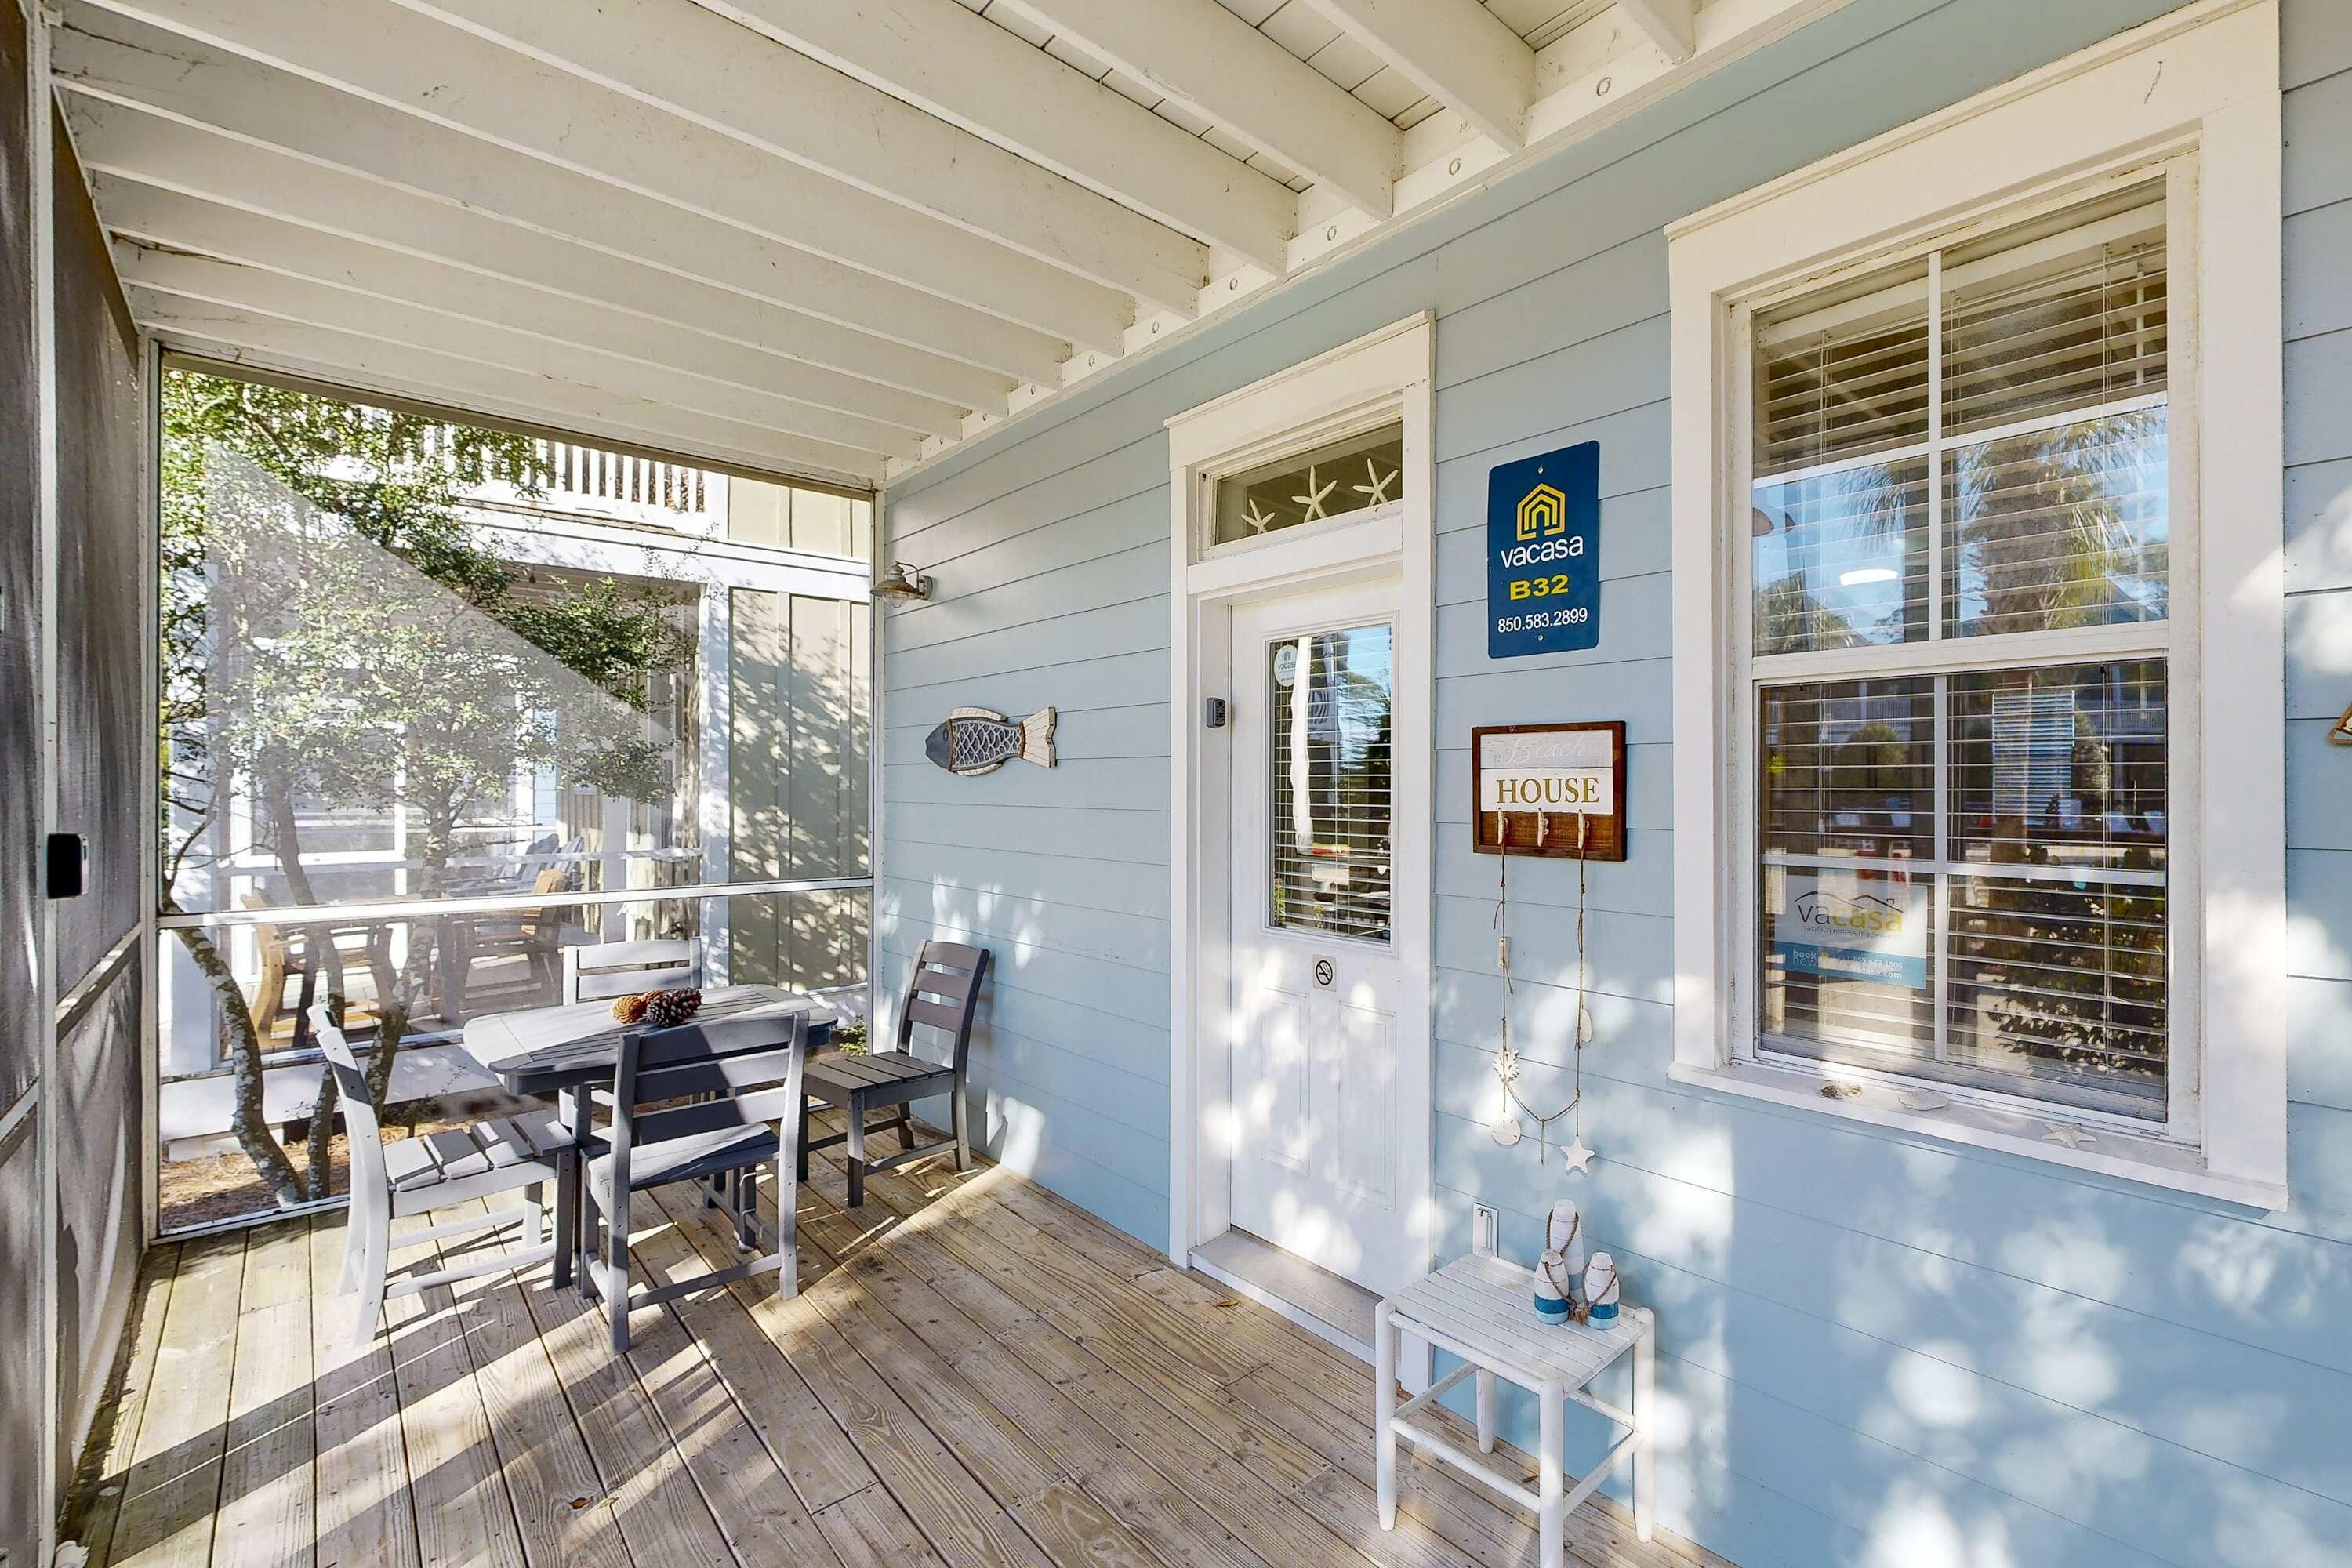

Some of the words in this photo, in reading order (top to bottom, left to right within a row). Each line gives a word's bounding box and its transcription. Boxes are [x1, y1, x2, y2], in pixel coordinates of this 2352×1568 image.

[1500, 535, 1584, 568] vacasa
[1509, 574, 1569, 601] B32
[1497, 607, 1588, 633] 850.583.2899
[1496, 778, 1600, 804] HOUSE
[1797, 904, 1903, 932] vacasa
[1793, 949, 1817, 959] book
[1793, 957, 1819, 967] now
